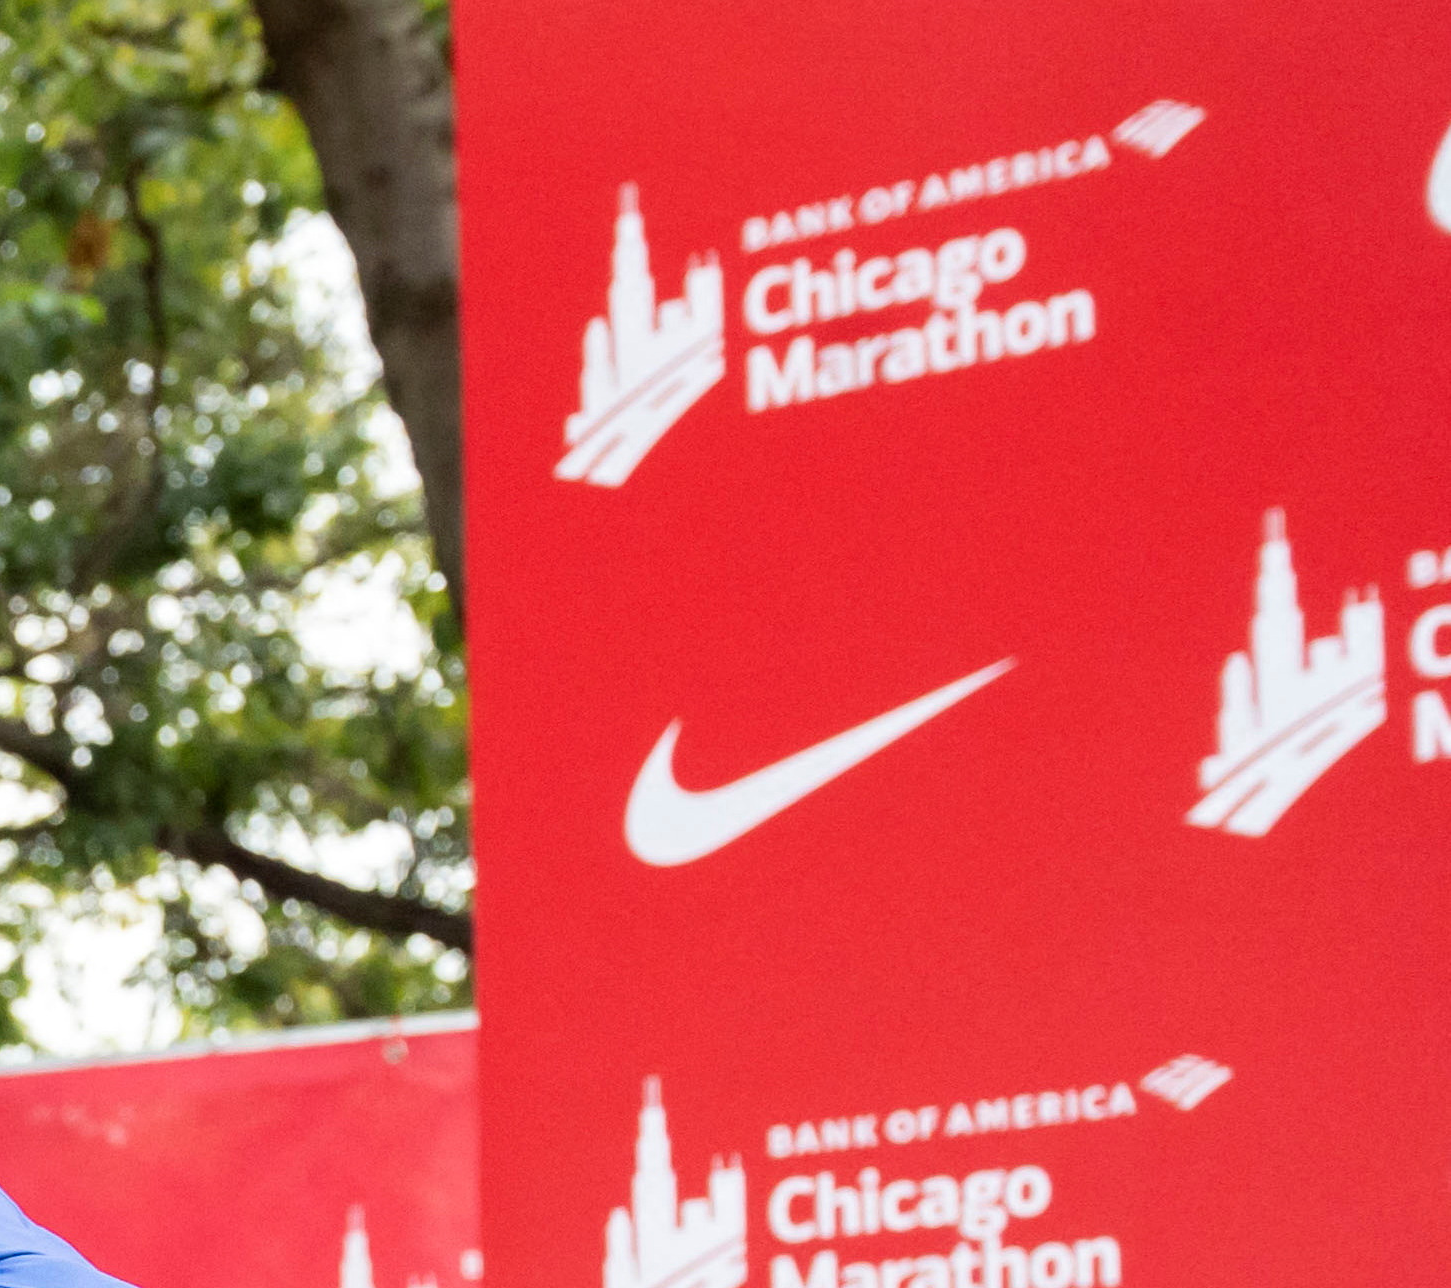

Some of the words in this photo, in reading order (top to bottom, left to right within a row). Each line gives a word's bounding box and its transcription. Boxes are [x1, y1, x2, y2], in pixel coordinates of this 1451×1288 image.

[742, 193, 854, 253] BANK
[858, 180, 915, 224] OF
[917, 134, 1111, 212] AMERICA
[742, 226, 1028, 336] Chicago
[746, 288, 1096, 413] Marathon
[767, 1113, 879, 1159] BANK
[883, 1105, 939, 1145] OF
[944, 1081, 1138, 1138] AMERICA
[767, 1164, 1053, 1244] Chicago
